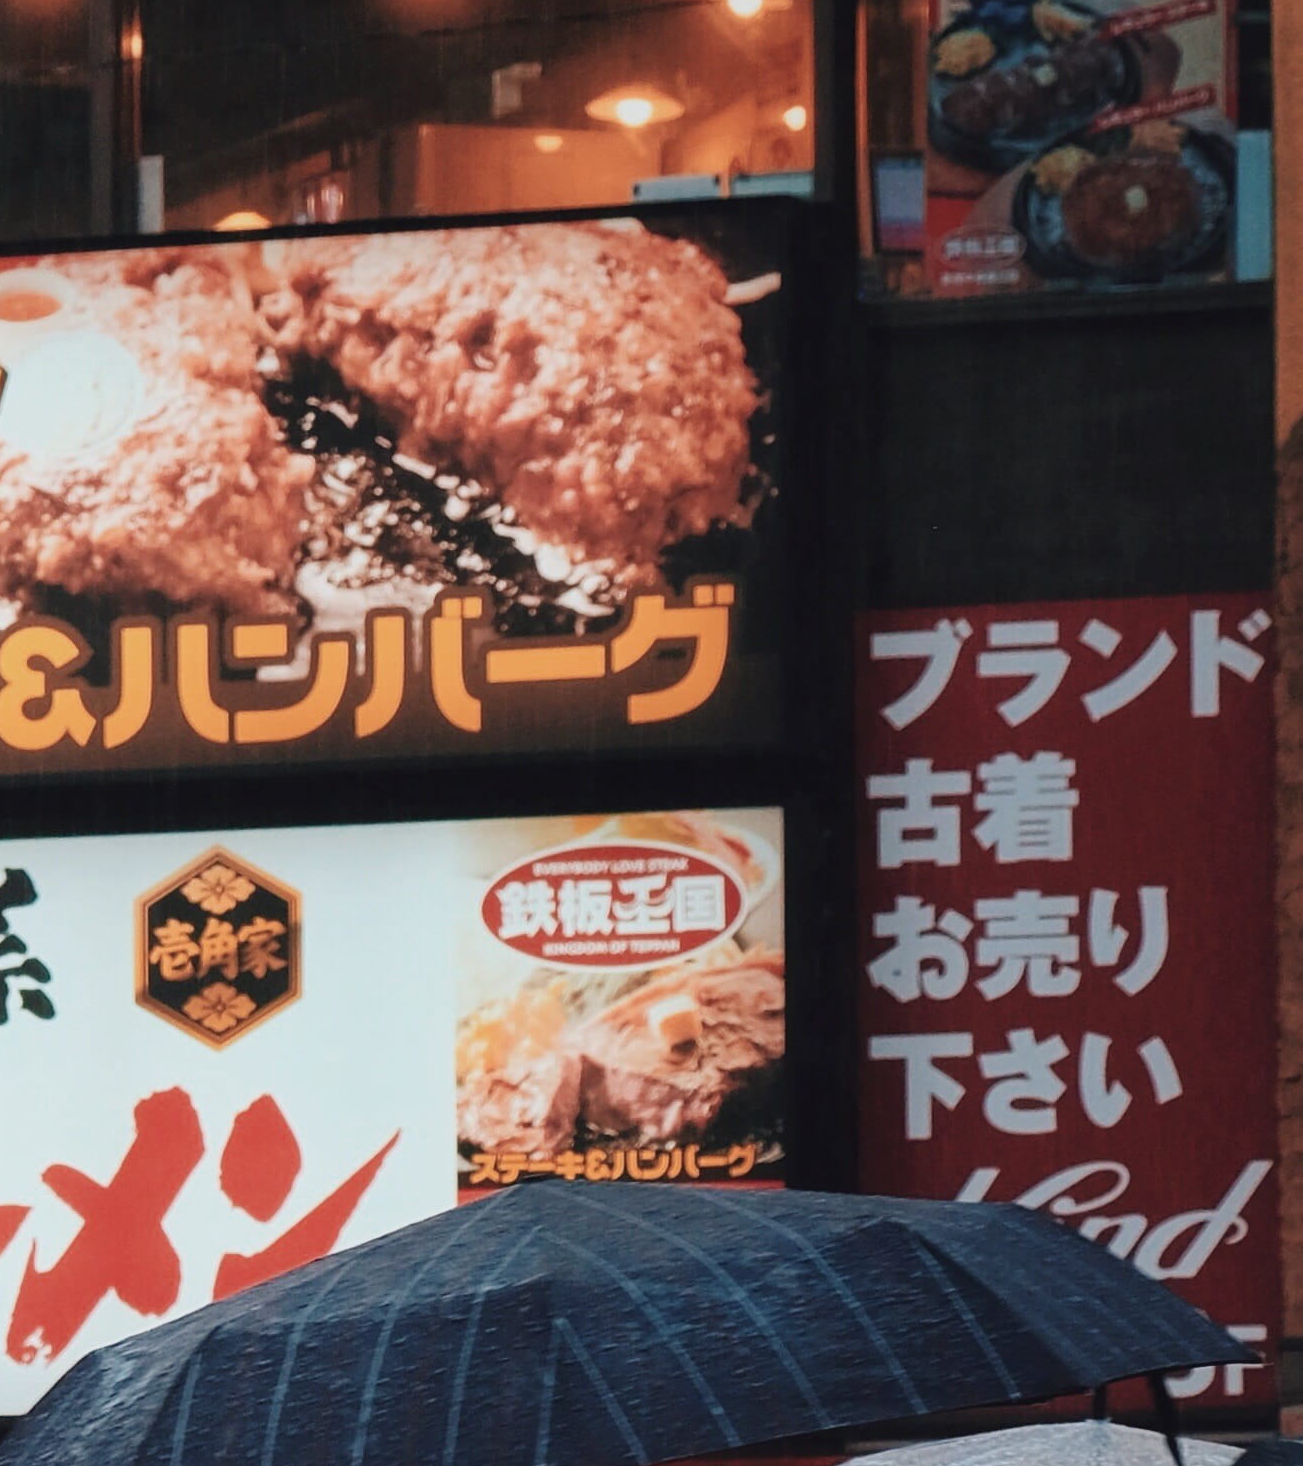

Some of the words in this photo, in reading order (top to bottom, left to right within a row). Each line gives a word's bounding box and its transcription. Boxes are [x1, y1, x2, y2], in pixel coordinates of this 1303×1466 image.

[869, 608, 1272, 731] ブランド
[867, 751, 1080, 869] 古着
[149, 916, 288, 981] 壱角家
[497, 874, 727, 940] 鉄板王国
[867, 885, 1170, 1003] お売り
[867, 1028, 1183, 1140] 下さい
[468, 1143, 760, 1185] ステーキ&ハンバーグ
